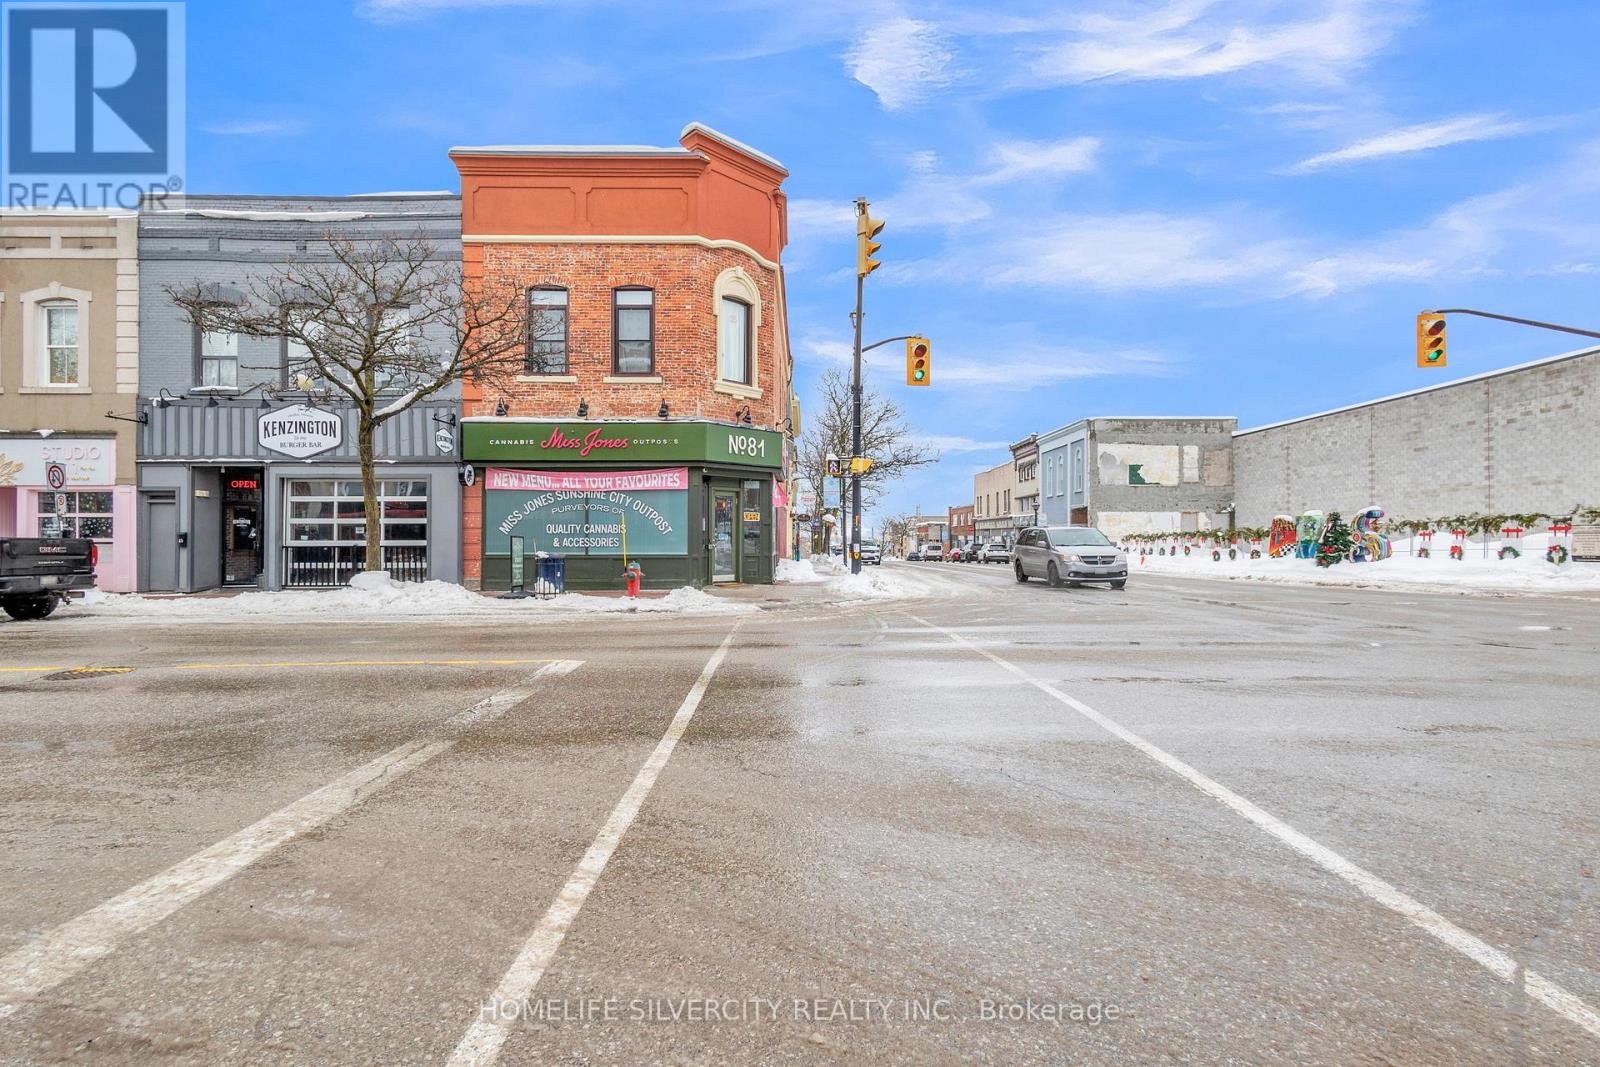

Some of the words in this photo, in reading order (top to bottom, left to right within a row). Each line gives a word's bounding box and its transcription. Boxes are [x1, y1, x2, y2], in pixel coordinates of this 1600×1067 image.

[263, 420, 337, 439] KENZINGTON
[280, 441, 308, 449] BURGER
[308, 441, 323, 449] BAR
[540, 424, 581, 449] Miss
[580, 427, 629, 456] Jones
[41, 447, 101, 460] STUDIO
[231, 480, 257, 489] OPEN
[493, 473, 519, 487] NEW
[562, 478, 582, 488] ALL
[584, 477, 612, 488] YOUR
[616, 473, 681, 488] FAVOURITES
[499, 510, 523, 534] MISS
[523, 492, 554, 515] JONES
[555, 490, 607, 500] SUNSHINE
[609, 491, 633, 507] CITY
[633, 500, 673, 535] OUTPOST
[551, 503, 610, 514] PURVEYORS
[546, 523, 581, 534] QUALITY
[583, 523, 627, 534] CANNABIS
[553, 537, 560, 547] &
[562, 537, 619, 547] ACCESSORIES
